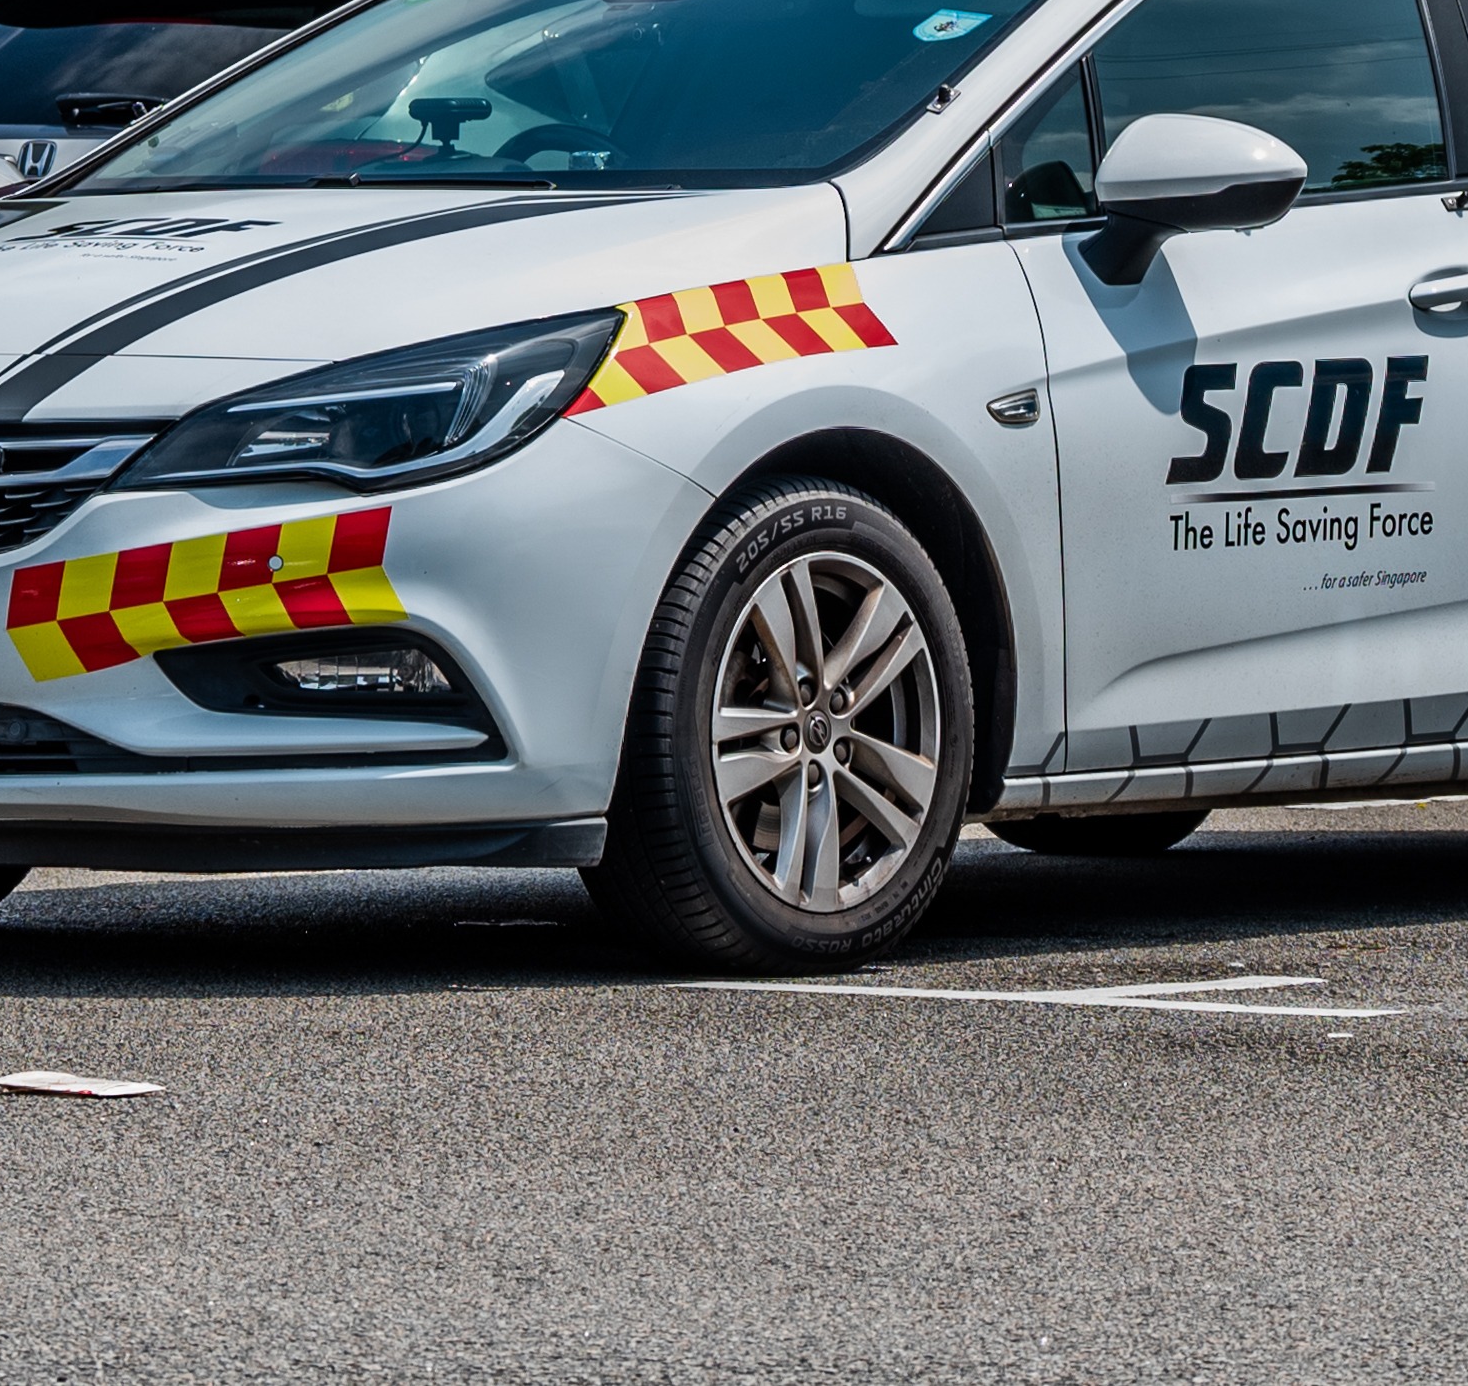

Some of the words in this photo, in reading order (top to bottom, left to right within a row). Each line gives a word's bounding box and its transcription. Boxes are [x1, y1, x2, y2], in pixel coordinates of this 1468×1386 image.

[4, 217, 284, 242] SCDF
[63, 240, 138, 251] Saving
[142, 241, 205, 252] Force
[1165, 355, 1429, 485] SCDF
[736, 509, 805, 574] 205/55
[811, 505, 847, 522] R16
[1170, 511, 1214, 550] The
[1224, 506, 1266, 547] Life
[1276, 507, 1359, 551] Saving
[1369, 503, 1434, 538] Force
[1338, 576, 1346, 589] a
[1346, 571, 1374, 588] safer
[1374, 570, 1427, 589] Singapore
[862, 856, 943, 948] Cinturato
[790, 934, 853, 955] ROSSO
